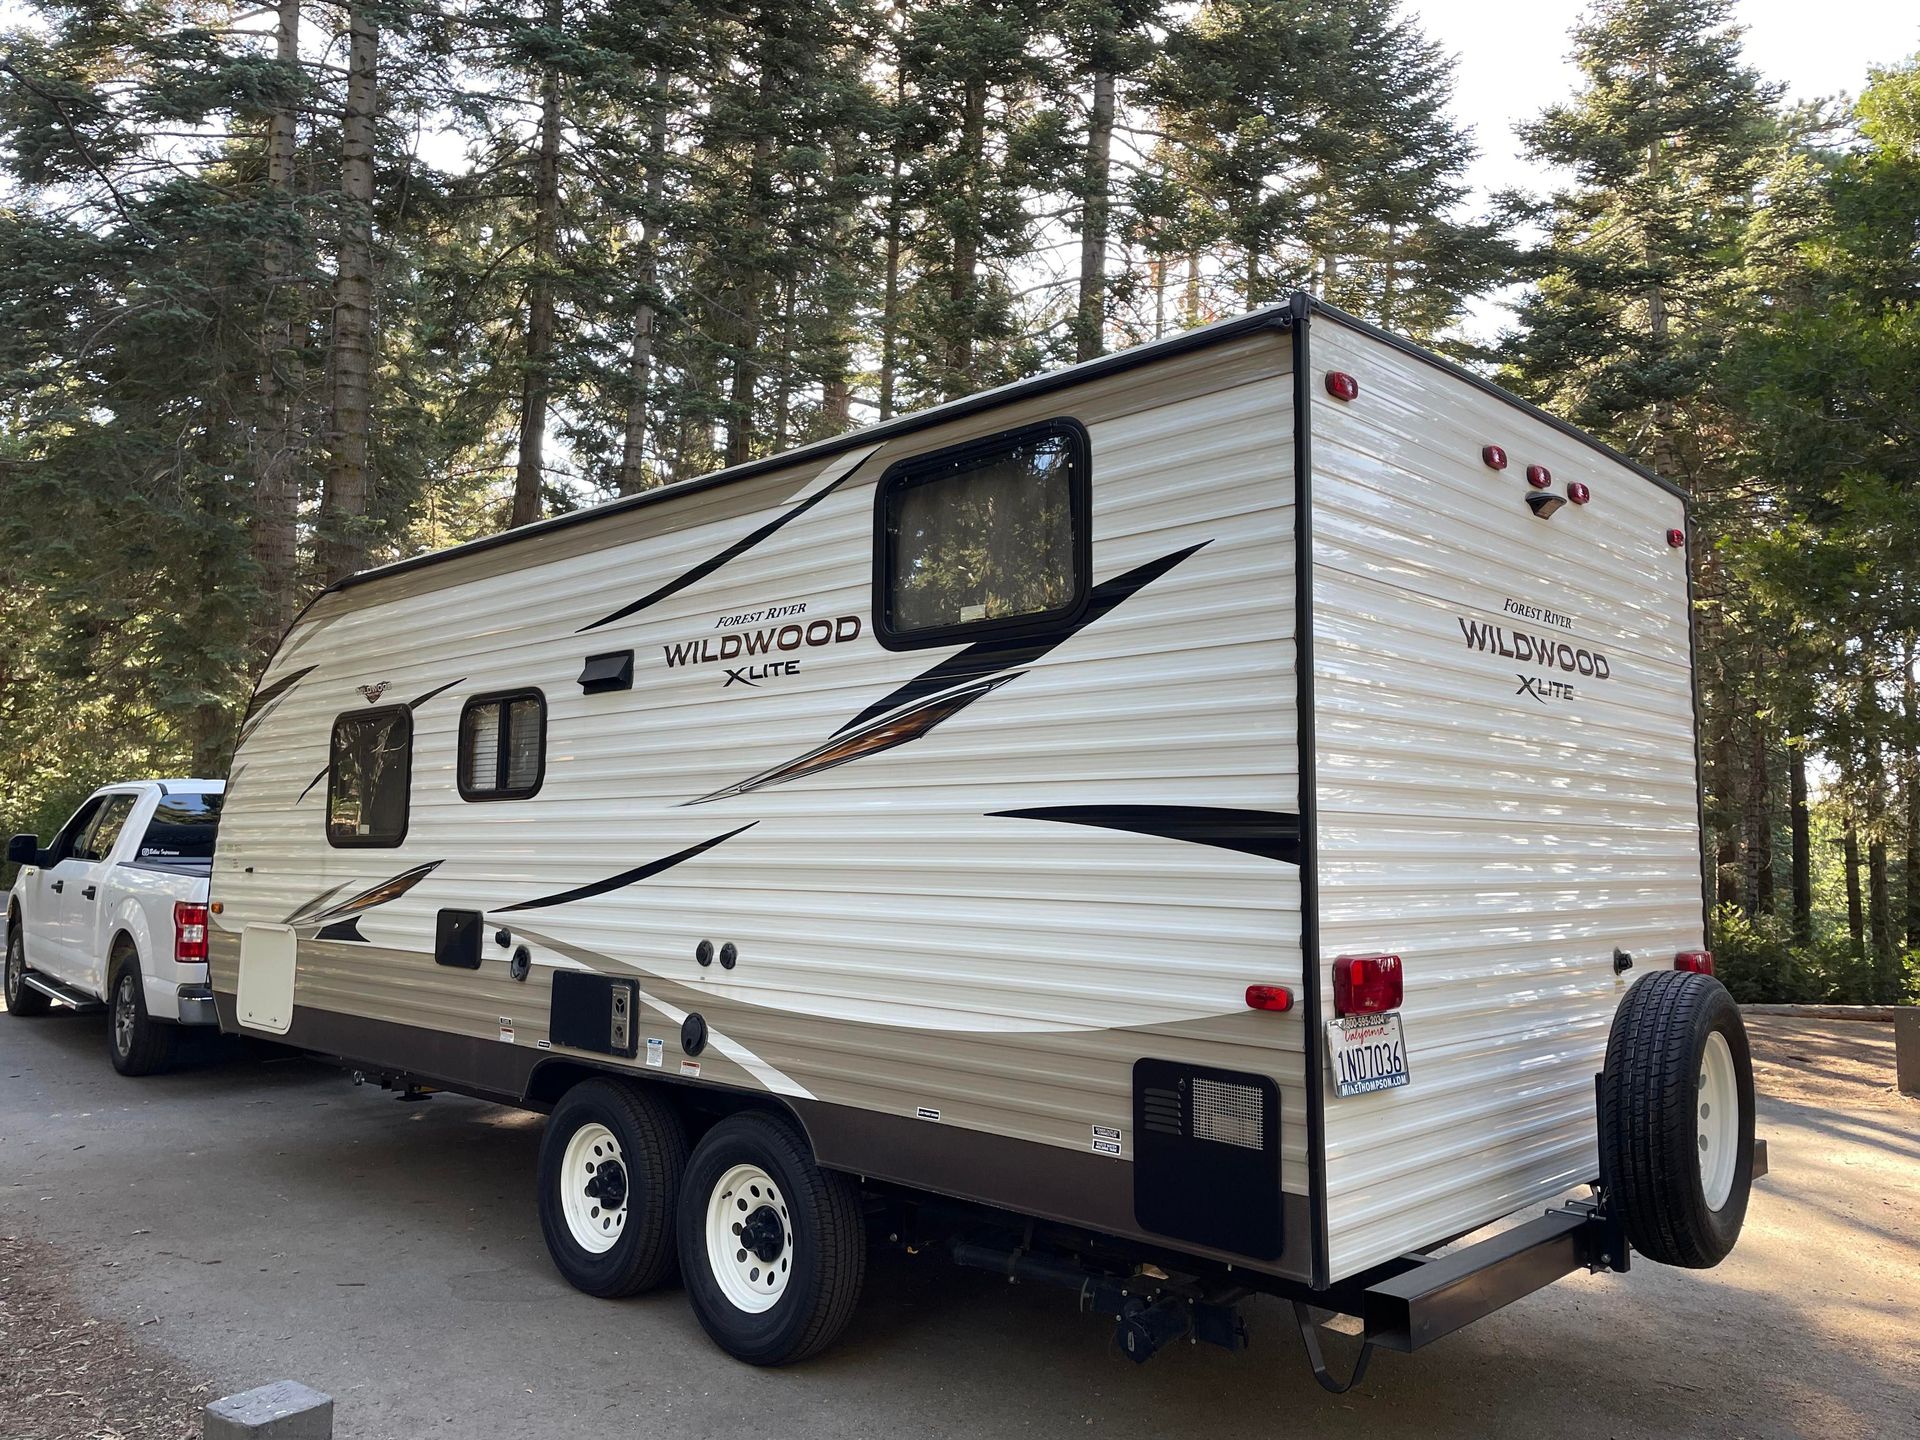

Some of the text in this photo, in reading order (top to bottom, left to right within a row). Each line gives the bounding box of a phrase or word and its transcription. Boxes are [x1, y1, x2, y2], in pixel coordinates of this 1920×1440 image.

[714, 602, 807, 629] FOREST RIVER
[1503, 598, 1572, 629] FOREST RIVER
[662, 615, 862, 668] WILDWOOD
[1457, 616, 1610, 680] WILDWOOD
[1344, 1027, 1389, 1045] California
[1338, 1041, 1402, 1083] 1ND7036
